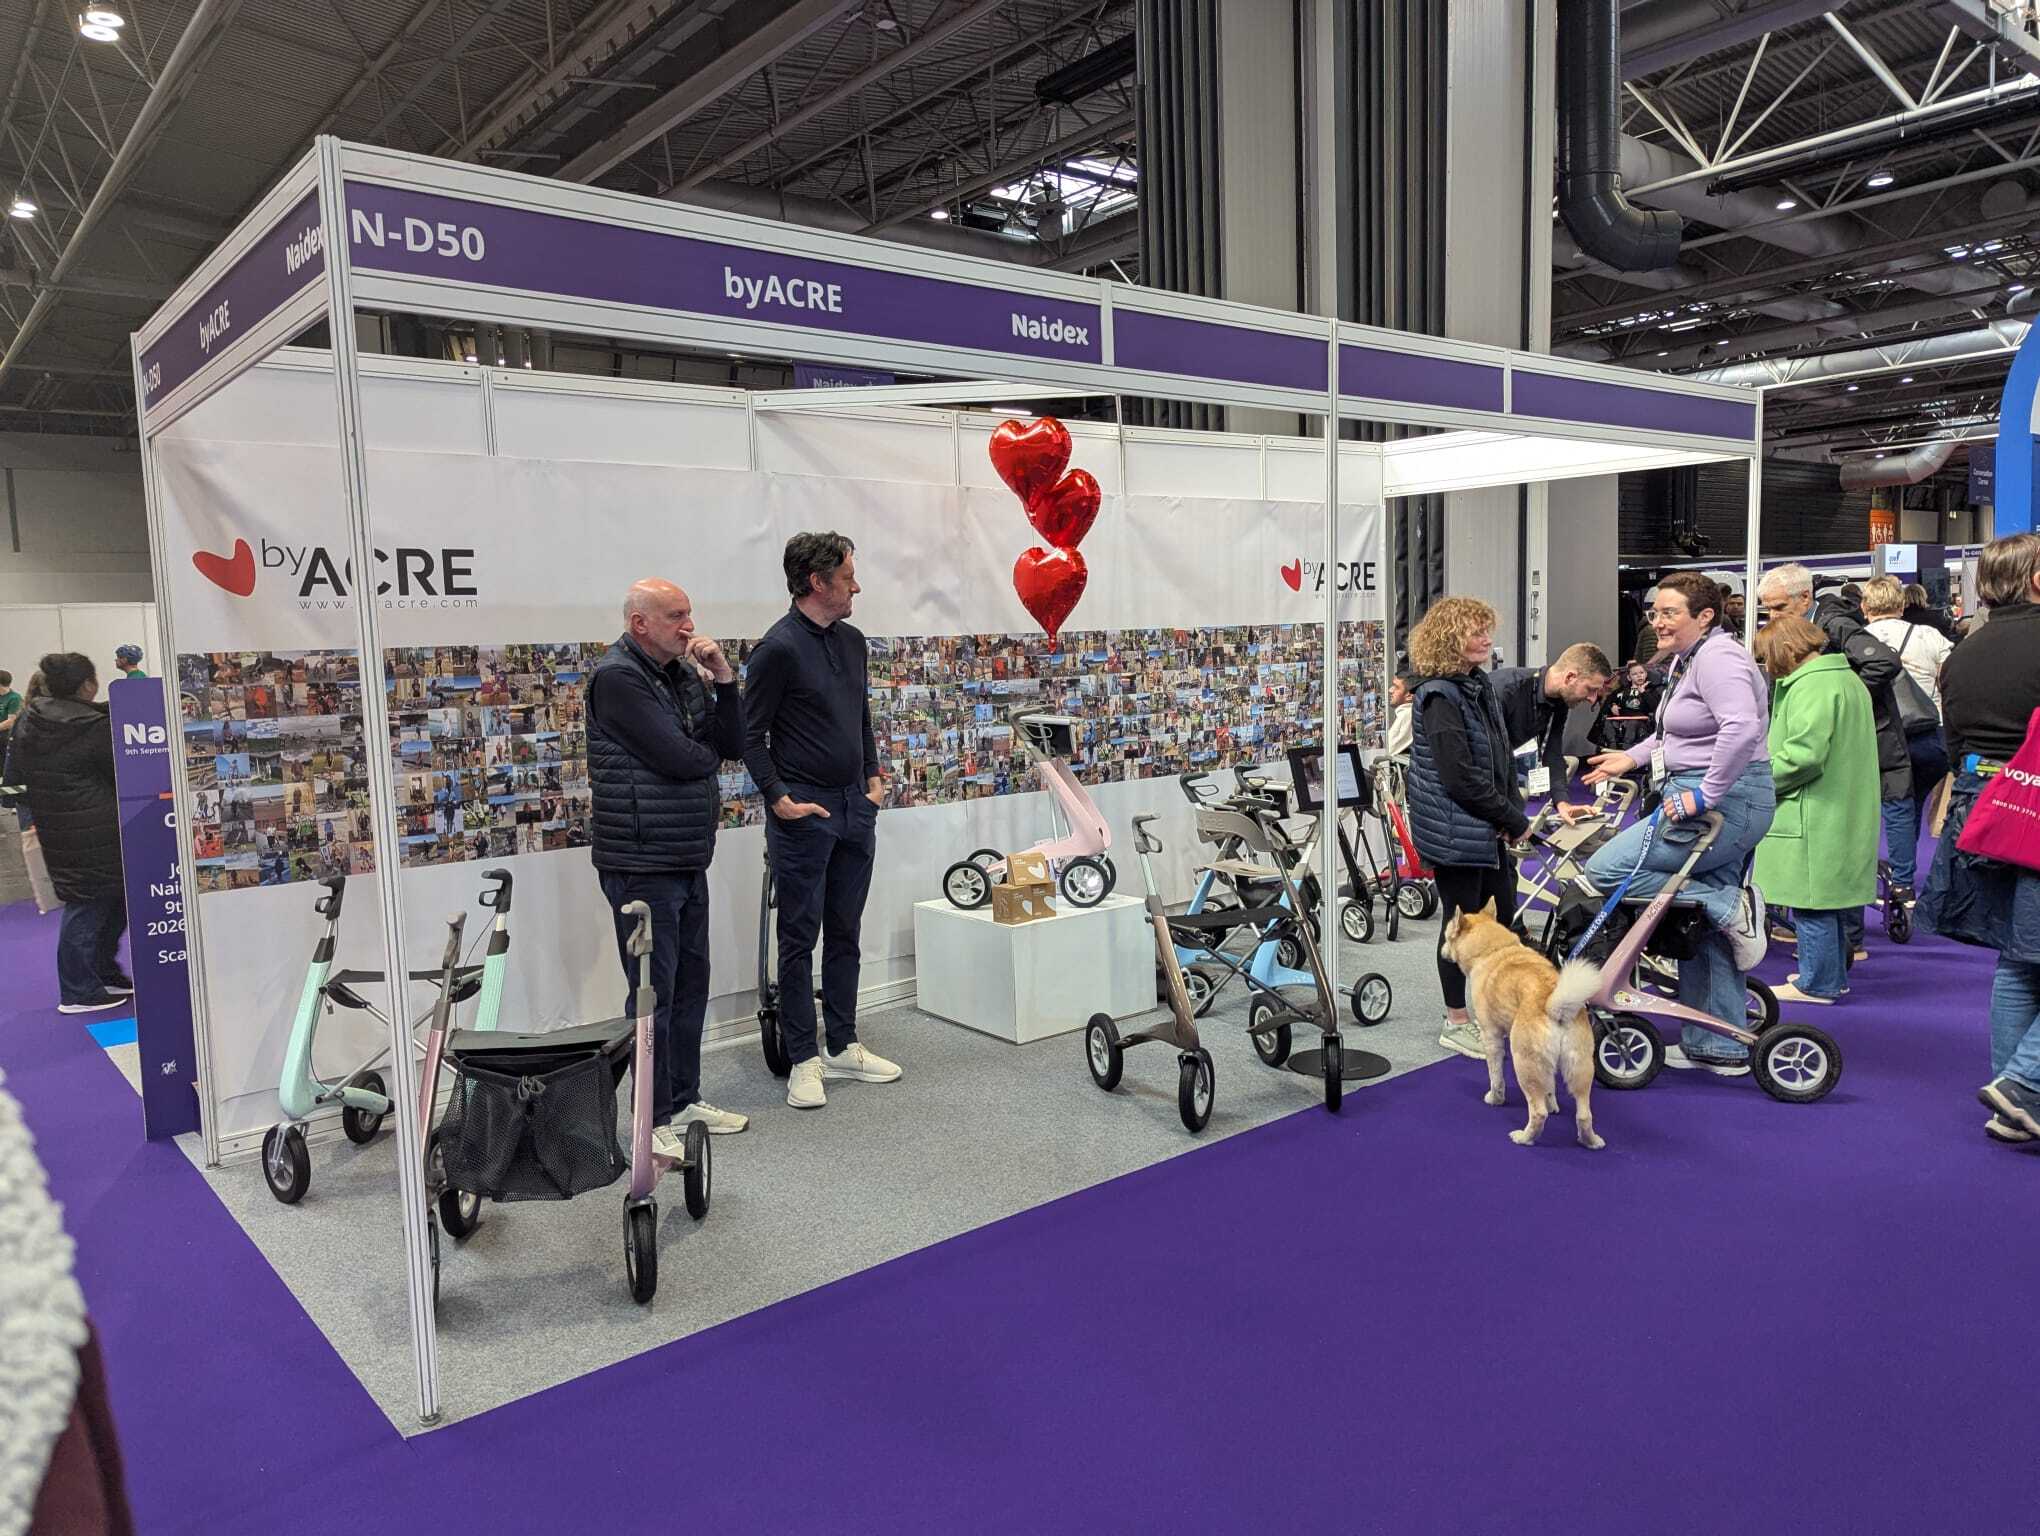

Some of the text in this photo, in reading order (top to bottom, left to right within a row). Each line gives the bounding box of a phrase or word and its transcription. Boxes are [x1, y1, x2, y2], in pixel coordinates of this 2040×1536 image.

[286, 226, 325, 275] Naidex
[351, 208, 485, 262] N-D50
[724, 266, 843, 314] byACRE
[199, 299, 231, 354] byACRE
[1011, 312, 1089, 346] Naidex
[125, 748, 138, 756] 9th
[150, 880, 182, 897] Nai
[147, 918, 186, 937] 2026
